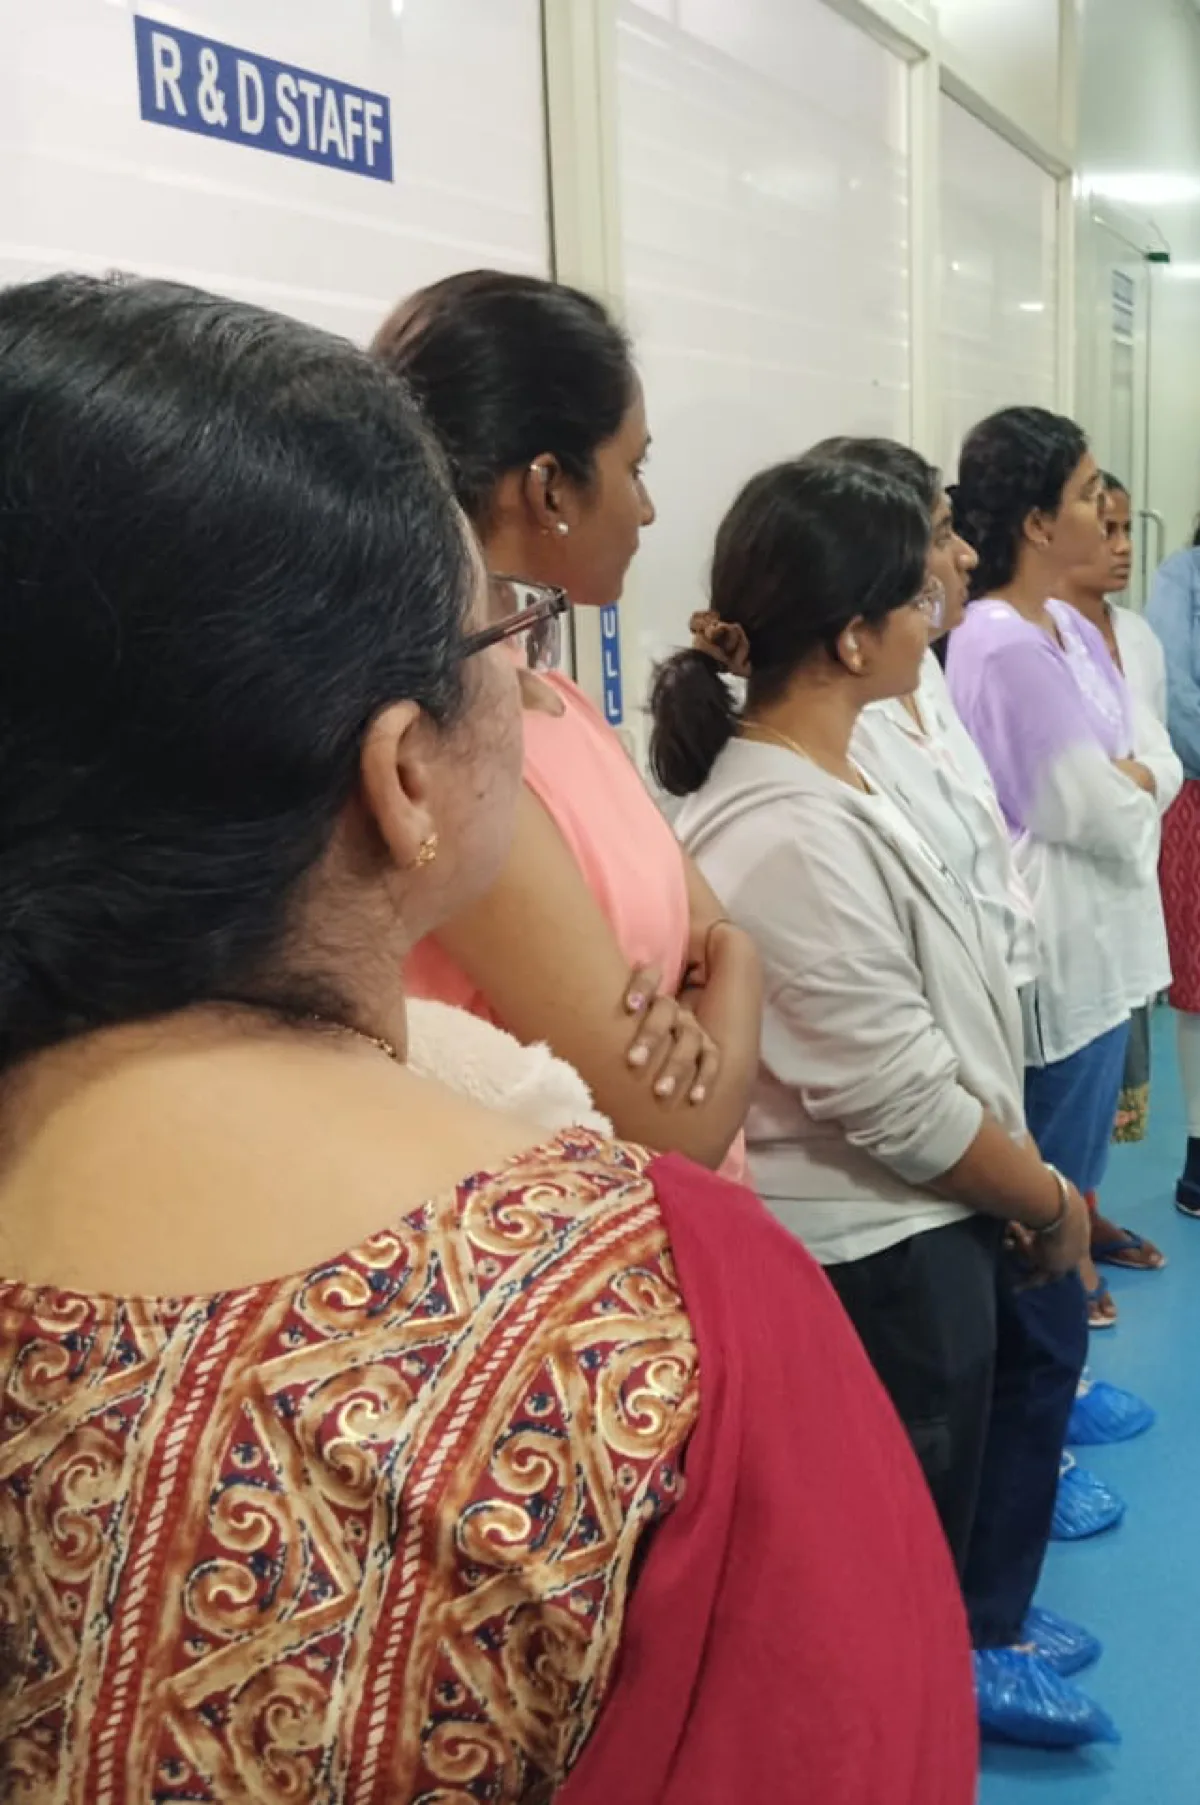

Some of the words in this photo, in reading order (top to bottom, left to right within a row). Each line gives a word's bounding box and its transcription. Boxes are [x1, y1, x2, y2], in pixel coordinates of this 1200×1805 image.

[151, 31, 187, 117] R
[197, 47, 228, 128] &
[236, 58, 265, 136] D
[275, 72, 383, 167] STAFF
[603, 610, 620, 717] ULL
